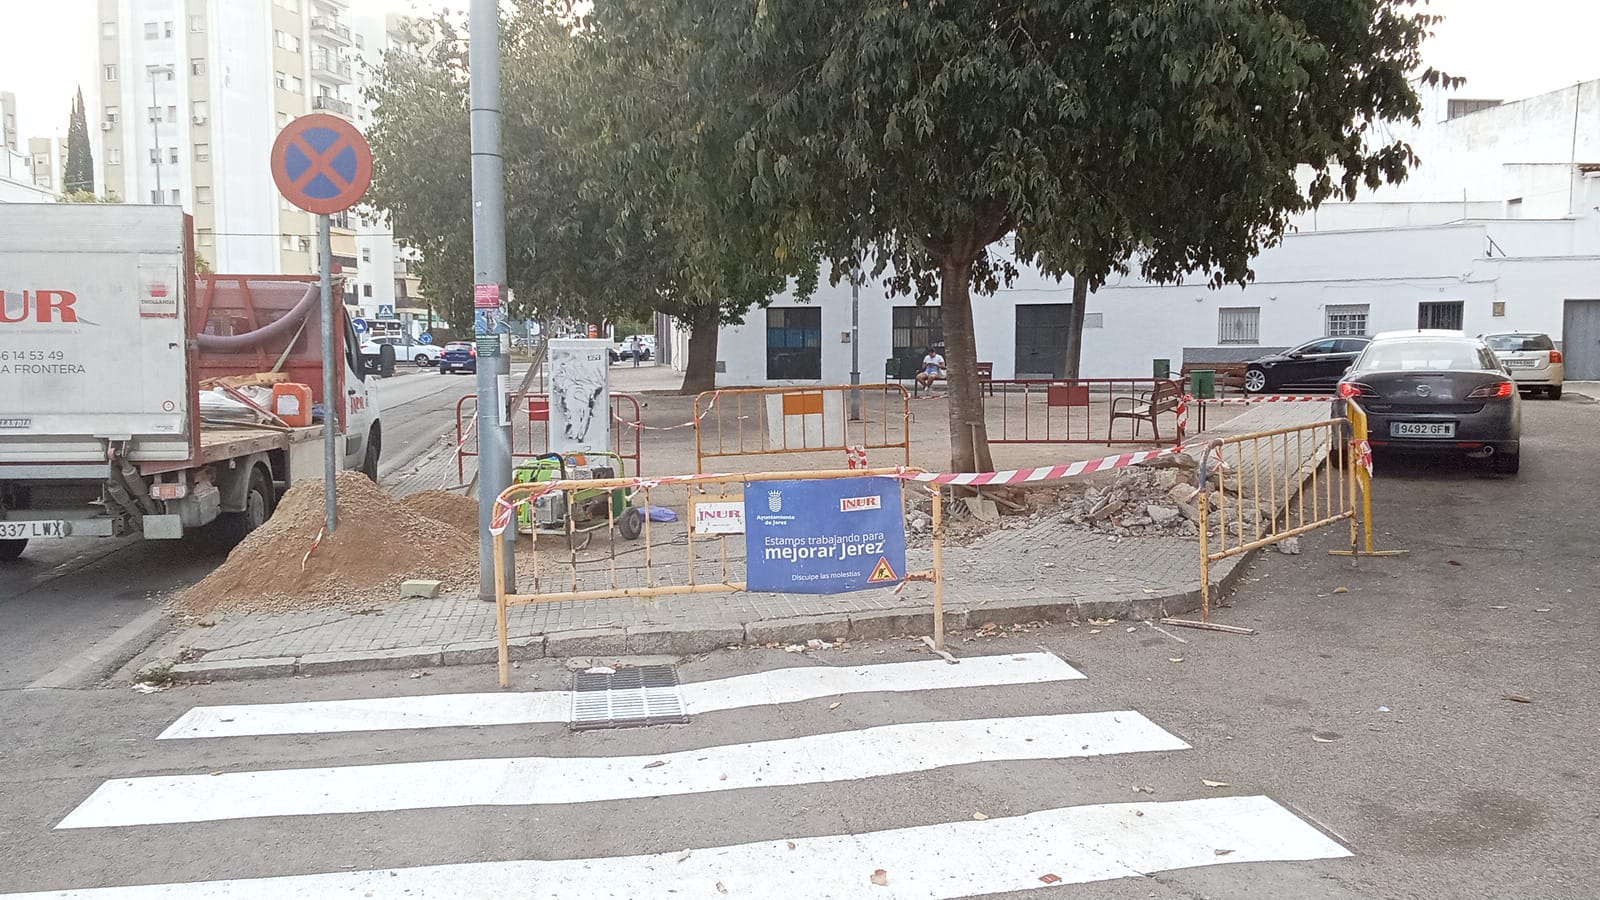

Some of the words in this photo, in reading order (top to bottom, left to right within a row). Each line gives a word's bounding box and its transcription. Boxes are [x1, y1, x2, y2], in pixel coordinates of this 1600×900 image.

[0, 350, 9, 360] 6
[13, 350, 25, 360] 14
[29, 350, 44, 360] 53
[48, 350, 64, 360] 49
[14, 364, 86, 374] FRONTERA
[1401, 424, 1427, 434] 9492
[842, 497, 877, 511] INUR
[700, 510, 740, 521] INUR
[32, 522, 62, 537] LWX
[765, 536, 806, 546] Estamos
[808, 533, 860, 545] trabajando
[862, 532, 884, 542] para
[765, 544, 837, 562] mejorar
[839, 542, 884, 560] Jerez
[791, 573, 819, 581] Disculpe
[830, 570, 861, 579] molestias
